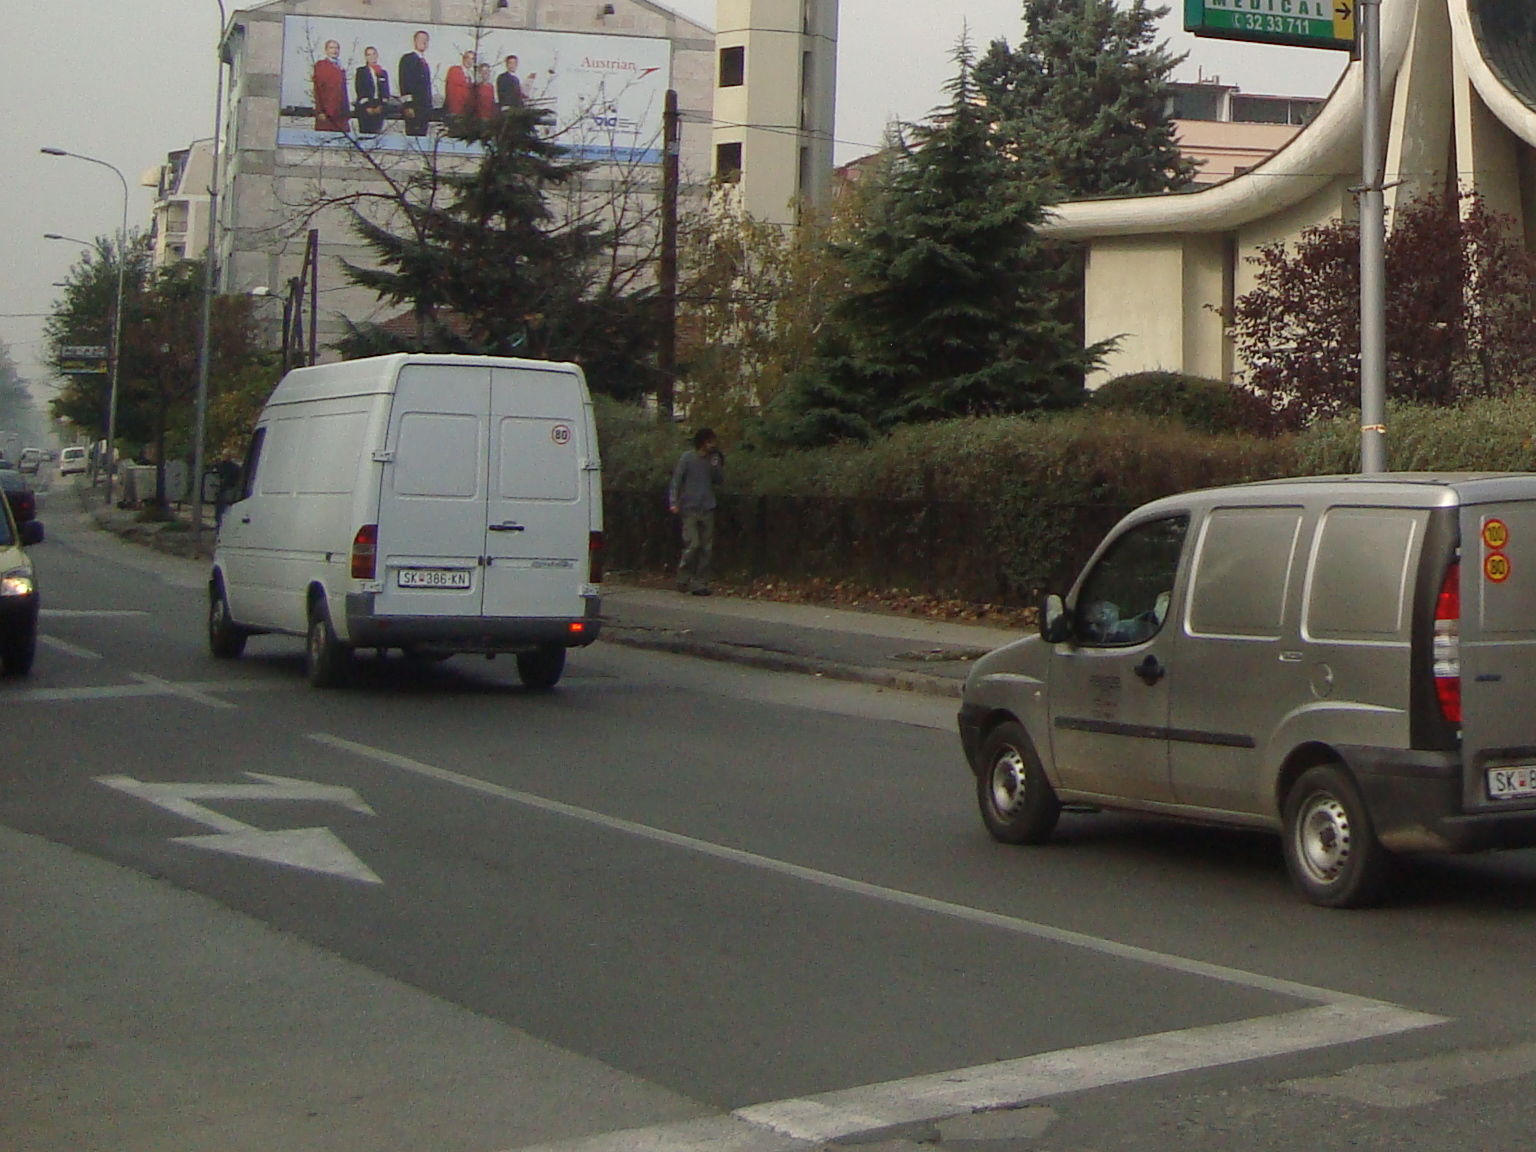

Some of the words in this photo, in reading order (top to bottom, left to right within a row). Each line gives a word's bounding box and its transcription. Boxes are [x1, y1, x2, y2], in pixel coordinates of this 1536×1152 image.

[1245, 13, 1263, 31] 32
[1266, 15, 1283, 32] 33
[1286, 18, 1310, 35] 711
[581, 56, 636, 71] Austrian
[555, 429, 568, 440] 80
[404, 572, 417, 584] SK
[1496, 771, 1517, 791] SK
